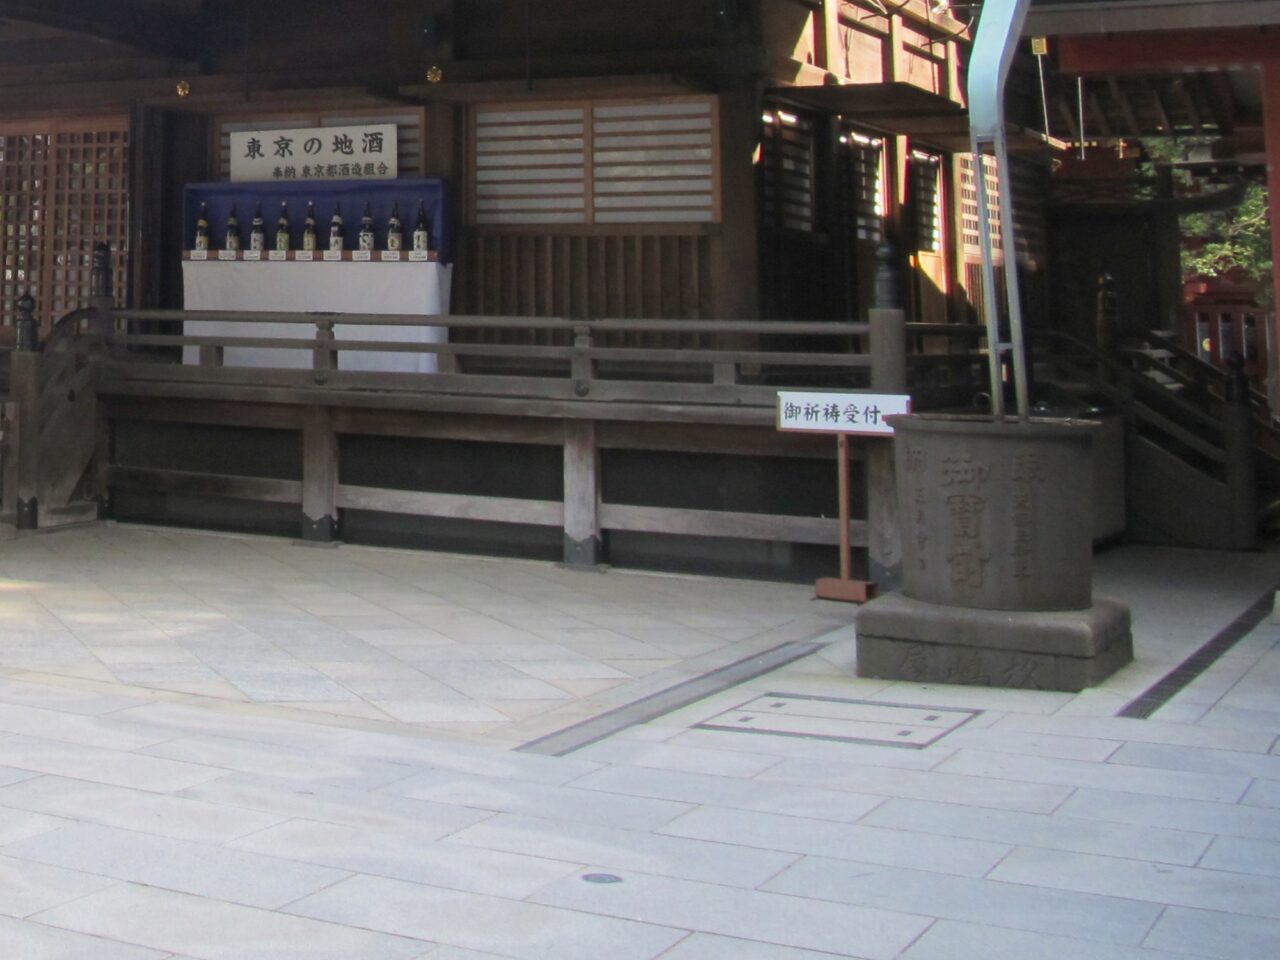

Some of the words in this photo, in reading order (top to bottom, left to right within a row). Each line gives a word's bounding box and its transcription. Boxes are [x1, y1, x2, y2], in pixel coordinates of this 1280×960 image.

[243, 130, 384, 160] 東京の地酒
[783, 401, 881, 425] 御祈祷受付
